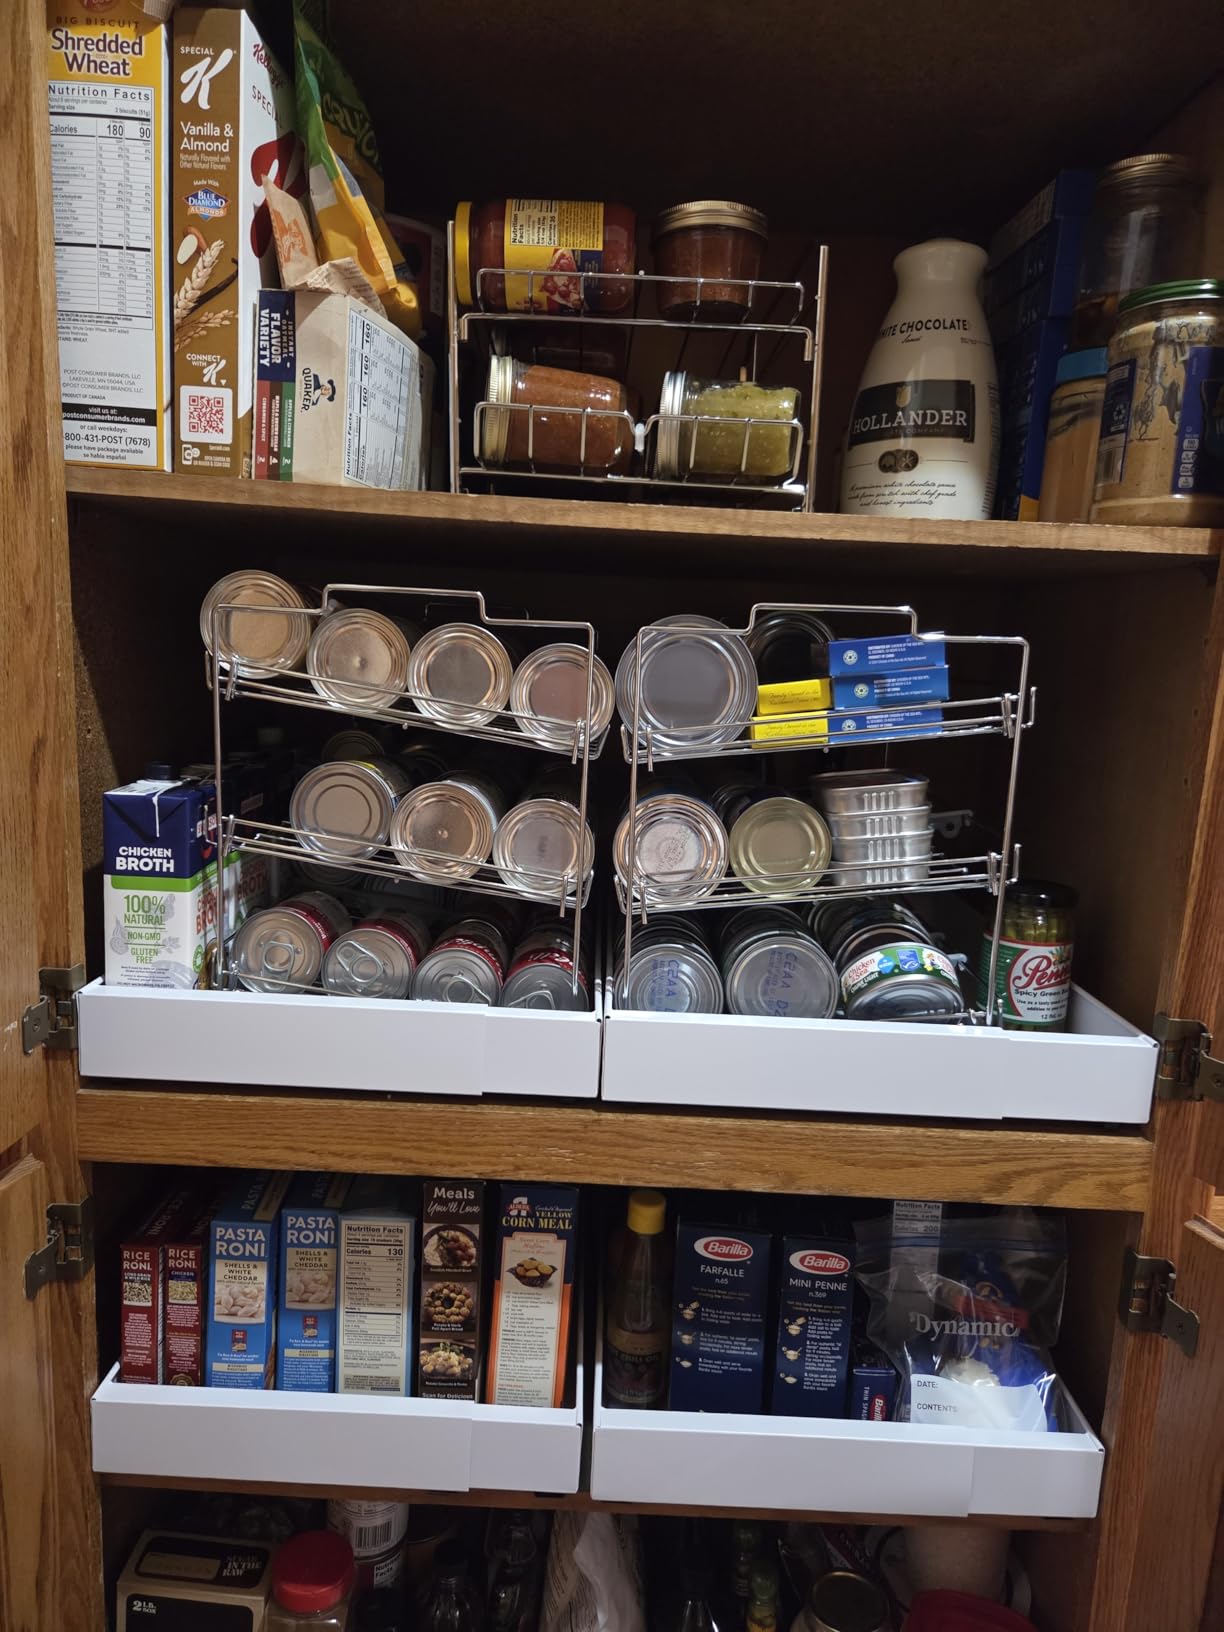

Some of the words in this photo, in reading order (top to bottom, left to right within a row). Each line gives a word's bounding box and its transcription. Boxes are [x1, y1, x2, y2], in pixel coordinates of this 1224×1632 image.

[56, 16, 78, 24] BIG
[86, 17, 140, 30] BISCUIT
[51, 28, 143, 56] Shredded
[180, 46, 214, 56] SPECIAL
[64, 52, 131, 76] Wheat
[48, 84, 108, 98] Nutrition
[114, 88, 150, 100] Facts
[106, 124, 124, 136] 180
[139, 127, 150, 139] 90
[180, 121, 220, 136] Vanilla
[222, 124, 234, 136] &
[180, 137, 230, 152] Almond
[188, 196, 226, 207] DIAMOND
[197, 190, 216, 202] BLUE
[900, 319, 968, 334] CHOCOLATE
[259, 308, 270, 368] VARIETY
[270, 312, 282, 364] FLAVOR
[186, 353, 220, 361] CONNECT
[302, 368, 312, 413] QUAKER
[62, 412, 146, 424] postconsumerbrands.com
[854, 410, 968, 434] HOLLANDER
[66, 444, 82, 452] please
[125, 436, 151, 448] (7678)
[118, 846, 172, 858] CHICKEN
[115, 857, 174, 873] BROTH
[124, 894, 166, 913] 100%
[124, 913, 166, 926] NATURAL
[127, 931, 161, 941] NON-GMO
[136, 956, 154, 964] FREE
[848, 958, 876, 980] Chicken
[863, 972, 879, 984] LIGHT
[1015, 989, 1037, 997] Spicy
[433, 1188, 475, 1200] Meals
[427, 1202, 458, 1216] You'll
[458, 1202, 480, 1213] Love
[287, 1216, 335, 1229] PASTA
[346, 1225, 381, 1233] Nutrition
[502, 1216, 535, 1228] CORN
[538, 1218, 572, 1229] MEAL
[216, 1228, 266, 1241] PASTA
[287, 1230, 334, 1244] RONI
[123, 1251, 150, 1261] RICE
[168, 1249, 196, 1259] RICE
[216, 1241, 266, 1257] RONI
[707, 1242, 748, 1256] Barilla
[804, 1255, 846, 1270] Barilla
[700, 1264, 744, 1278] FARFALLE
[790, 1278, 812, 1289] MINI
[815, 1281, 848, 1292] PENNE
[914, 1313, 1020, 1342] Dynamic
[917, 1380, 938, 1388] DATE:
[132, 1600, 142, 1612] 2
